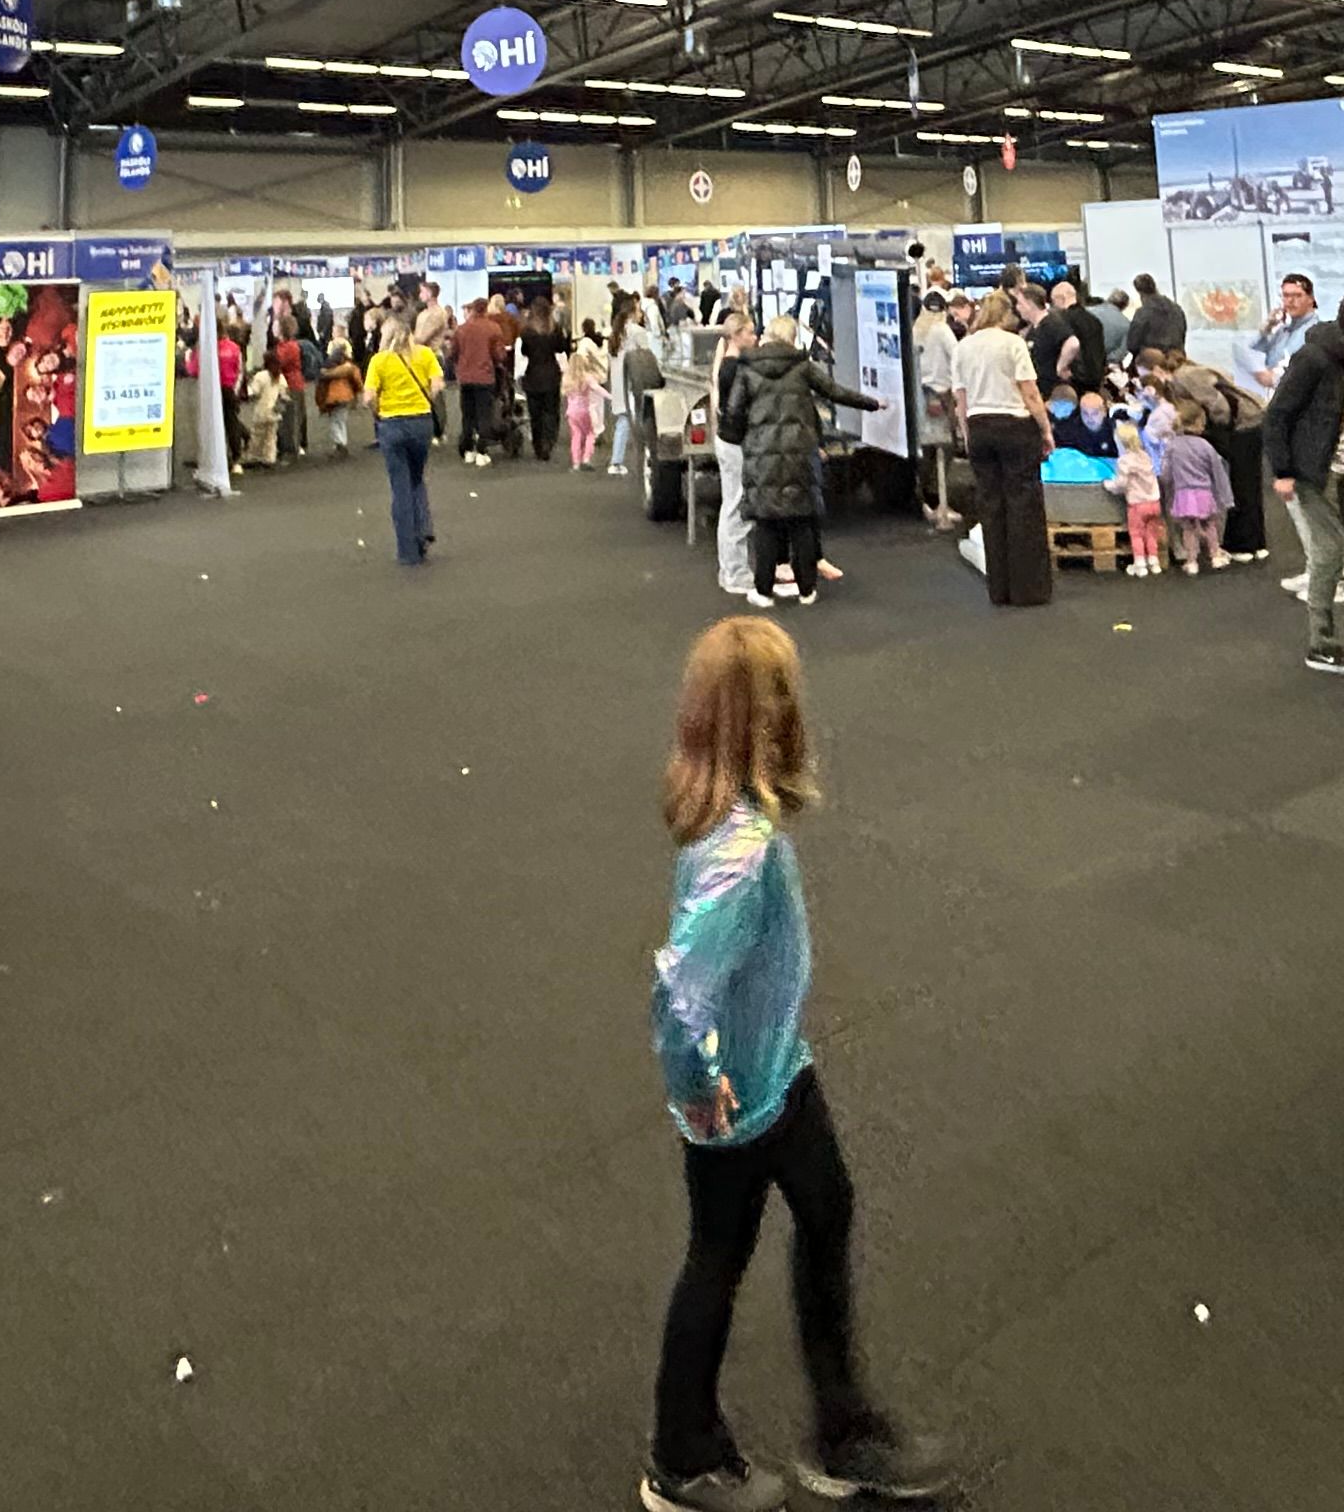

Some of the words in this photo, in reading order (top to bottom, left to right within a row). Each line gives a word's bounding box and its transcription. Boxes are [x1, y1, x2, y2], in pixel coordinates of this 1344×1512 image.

[499, 30, 536, 68] HÍ
[527, 156, 549, 179] HÍ
[27, 247, 54, 276] HÍ
